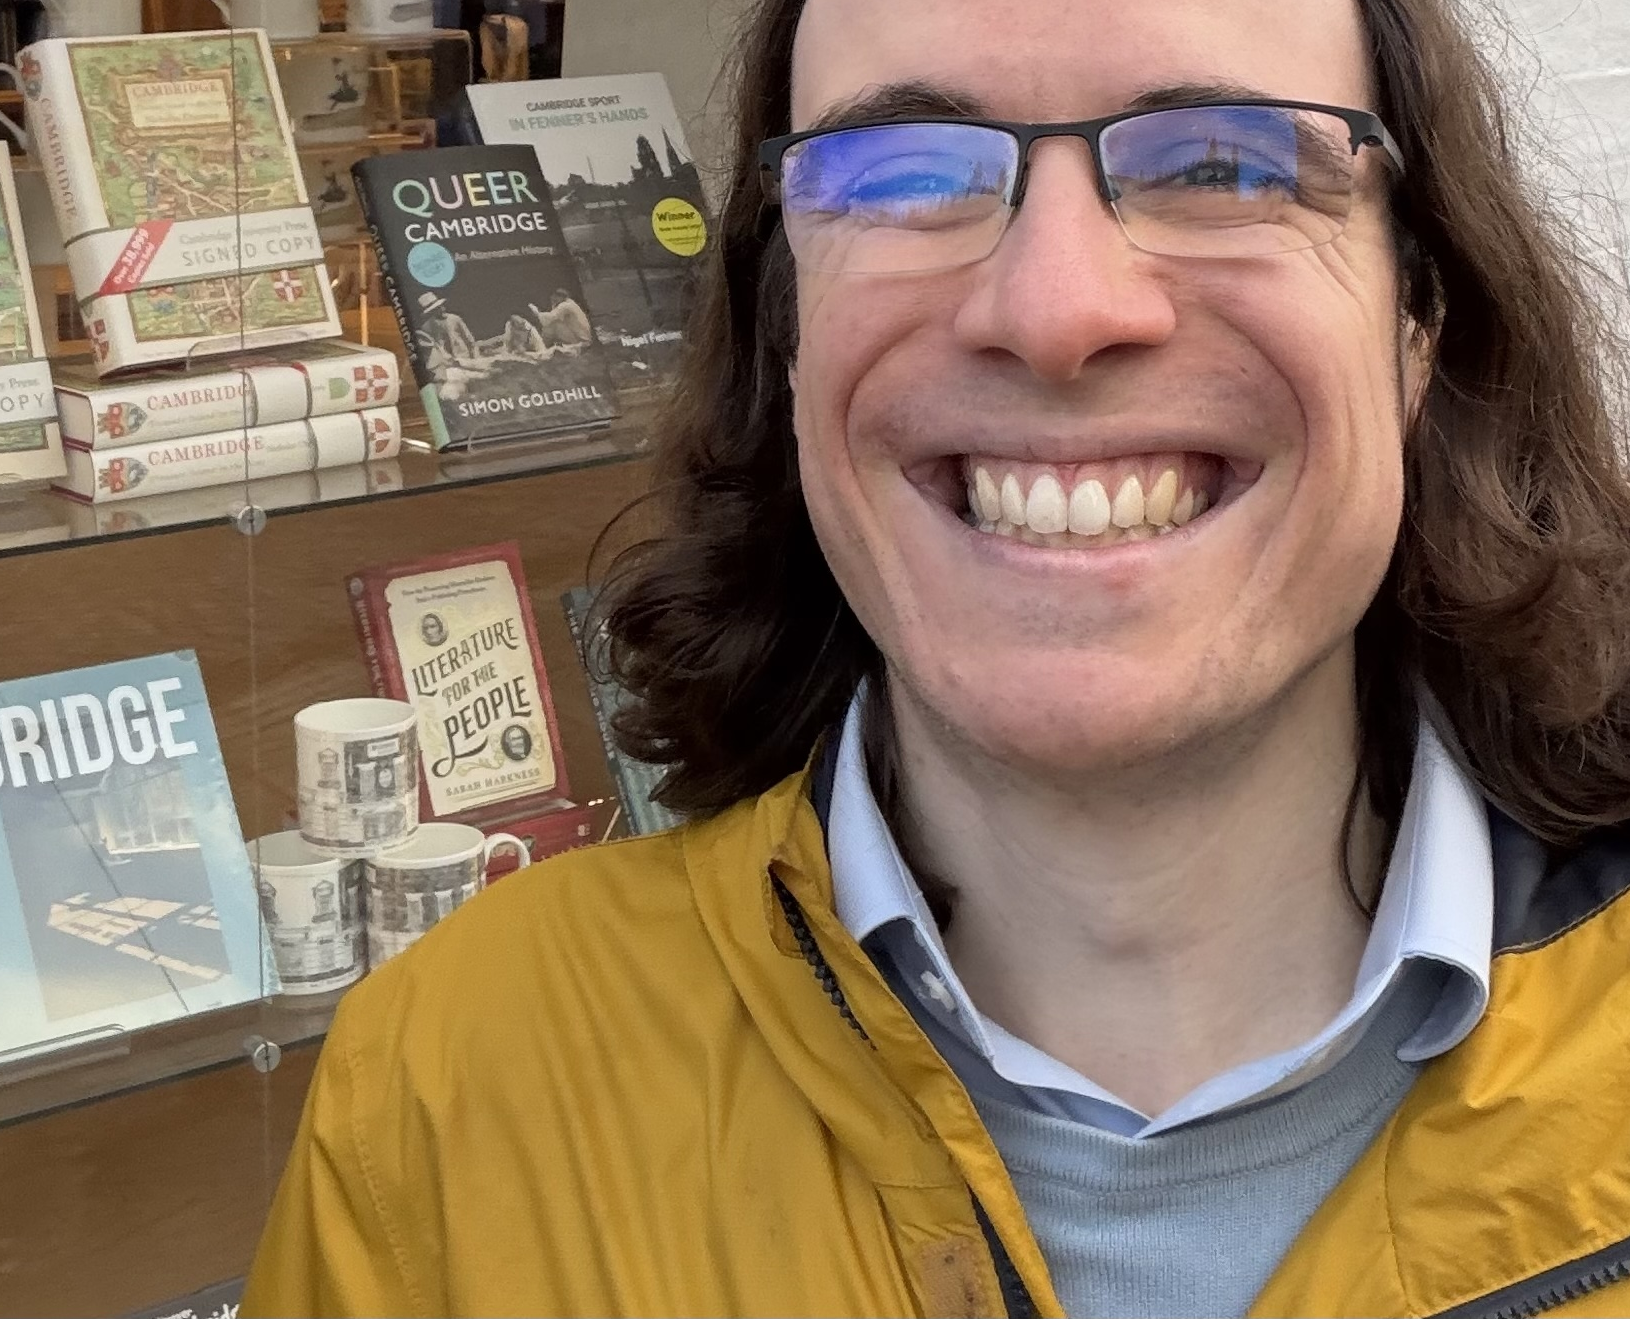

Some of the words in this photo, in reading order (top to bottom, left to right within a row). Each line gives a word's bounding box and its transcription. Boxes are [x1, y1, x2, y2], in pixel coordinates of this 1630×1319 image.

[526, 97, 586, 111] CAMBRIDGE
[589, 94, 621, 107] SPORT
[509, 117, 526, 131] IN
[528, 111, 597, 131] FENNER'S
[599, 107, 650, 123] HANDS
[392, 170, 539, 218] QUEER
[405, 212, 548, 243] CAMBRIDGE
[656, 209, 696, 224] Winner
[266, 235, 316, 257] COPY
[147, 384, 251, 413] CAMBRIDG
[459, 396, 515, 418] SIMON
[518, 385, 602, 409] GOLDHILL
[148, 438, 265, 467] CAMBRIDGE
[411, 618, 519, 697] LITERATURE
[441, 676, 472, 707] FOR
[473, 661, 499, 687] THE
[432, 676, 532, 777] PEOPLE
[446, 779, 482, 797] SARAH
[484, 767, 541, 788] HARKNESS
